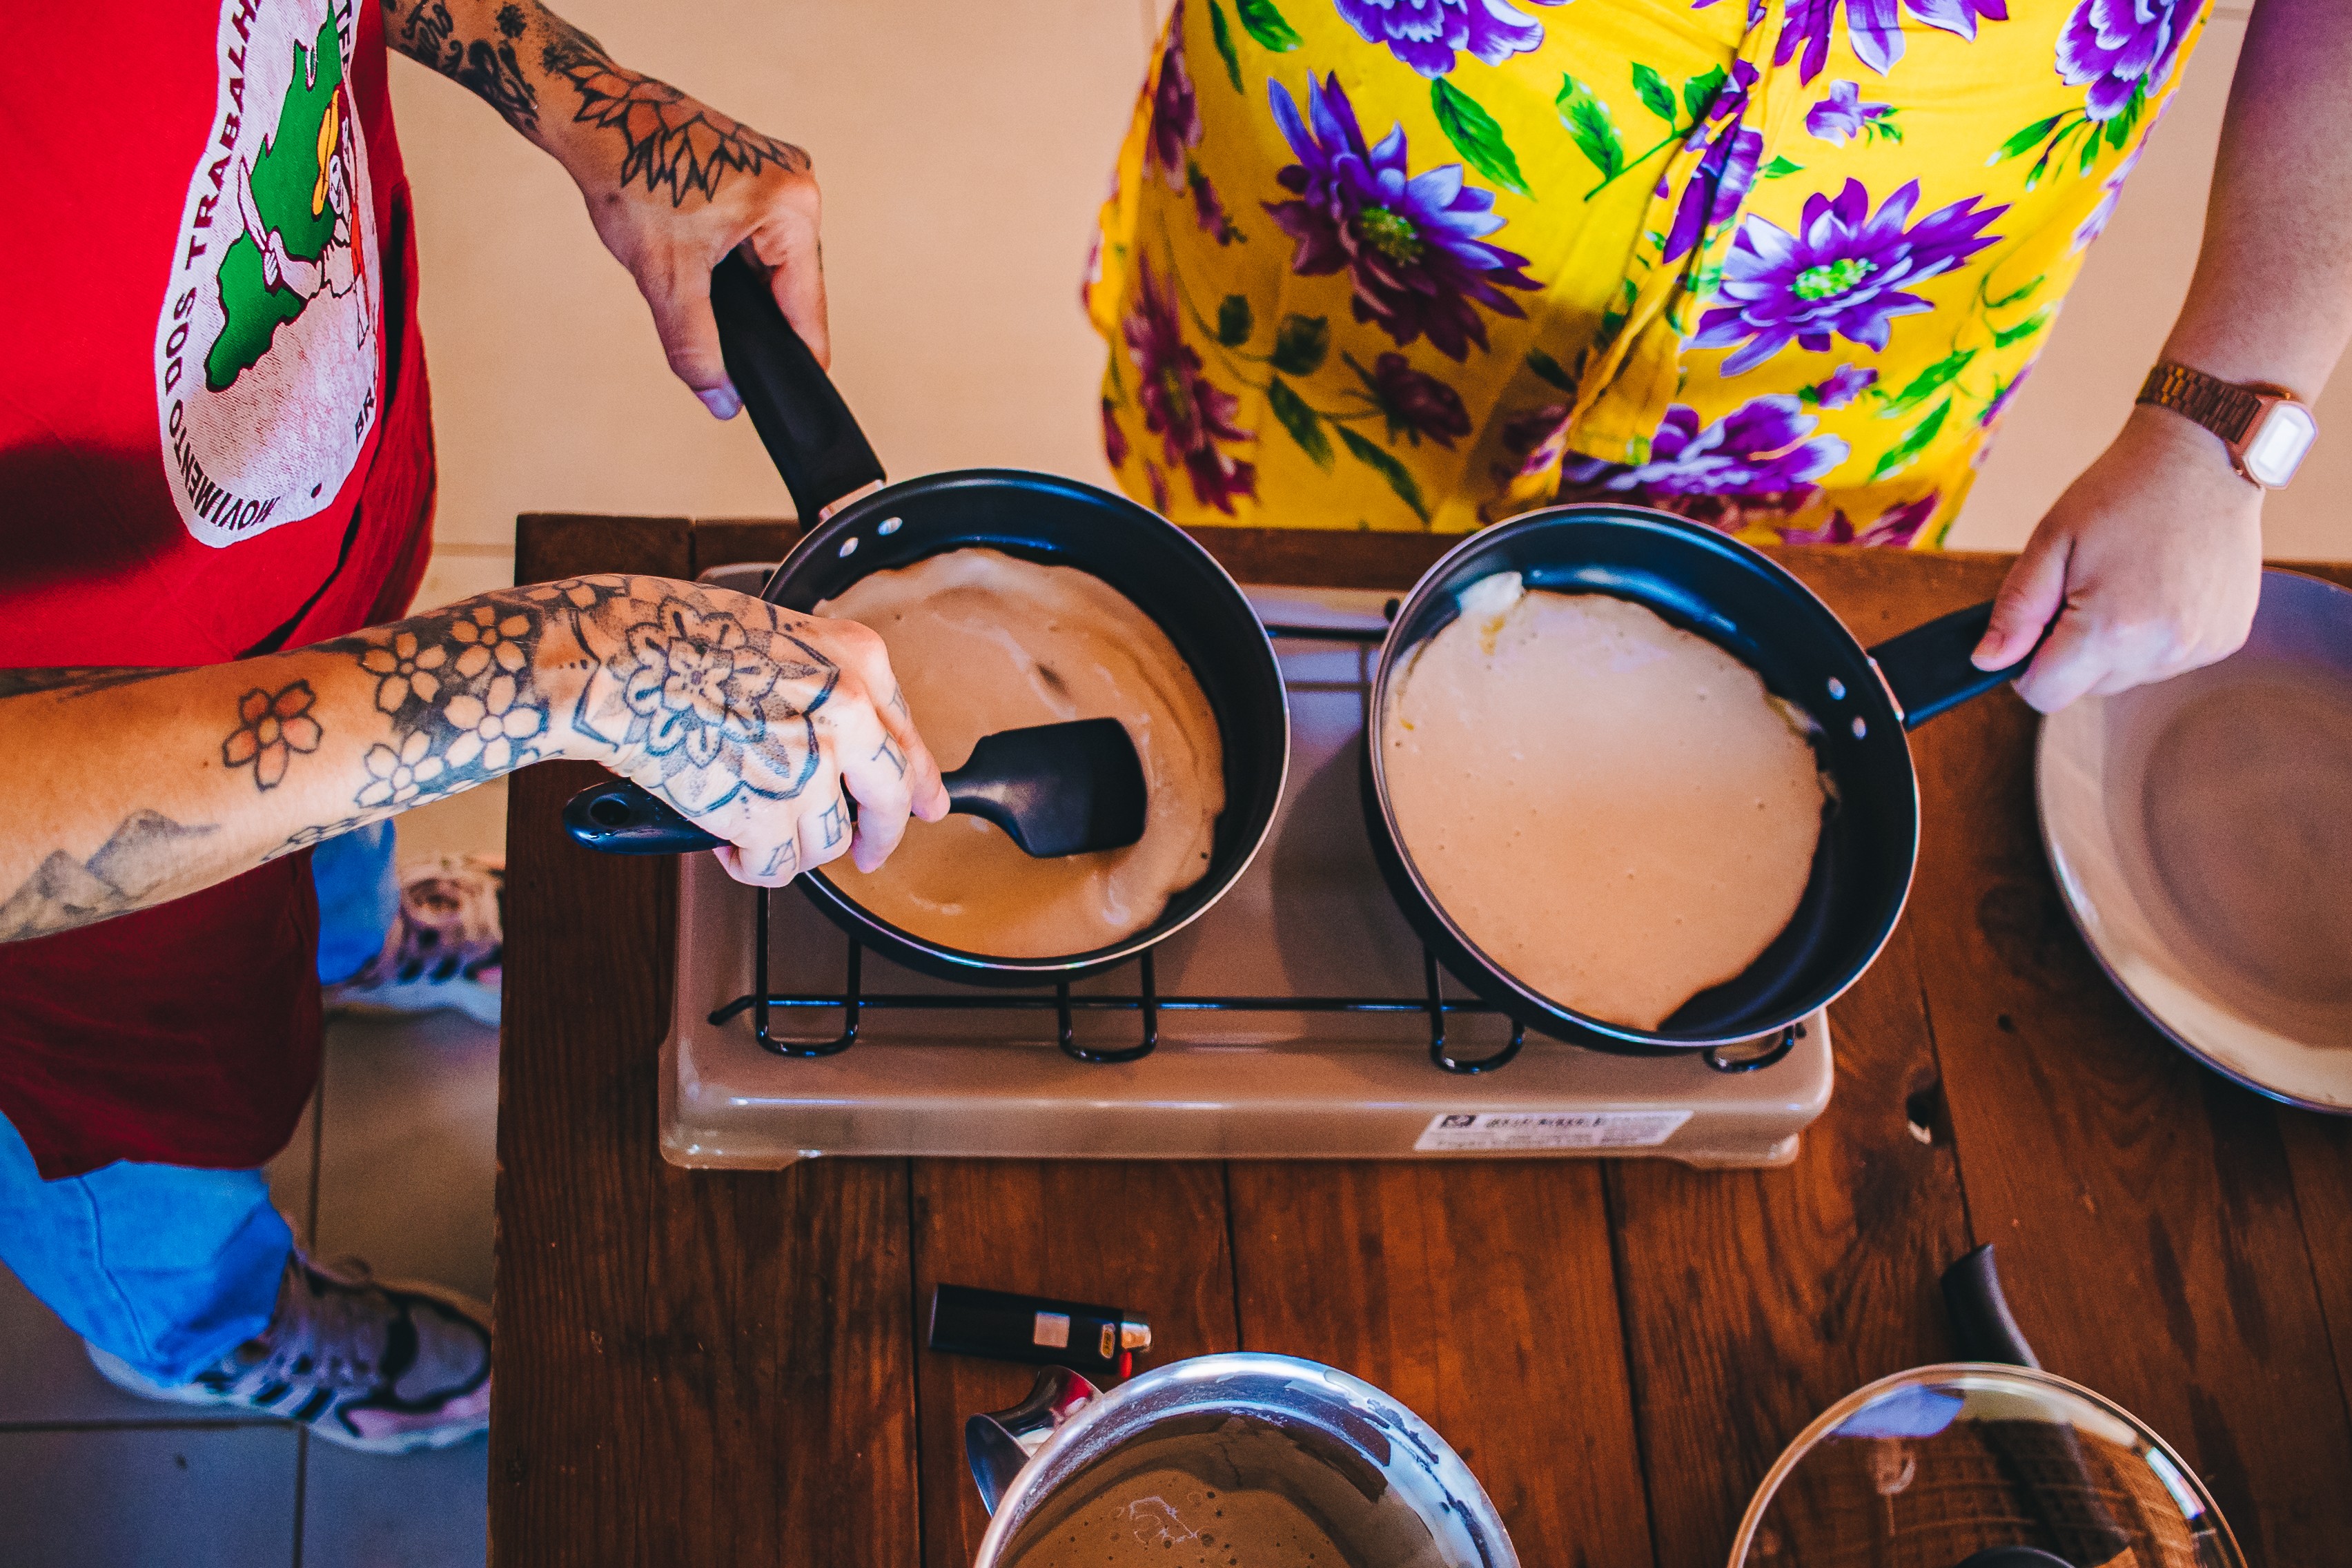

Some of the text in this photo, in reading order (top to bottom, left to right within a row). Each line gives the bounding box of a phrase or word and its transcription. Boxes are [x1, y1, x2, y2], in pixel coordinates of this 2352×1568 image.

[165, 0, 281, 531] MOVIMENTO DOS TRABALH
